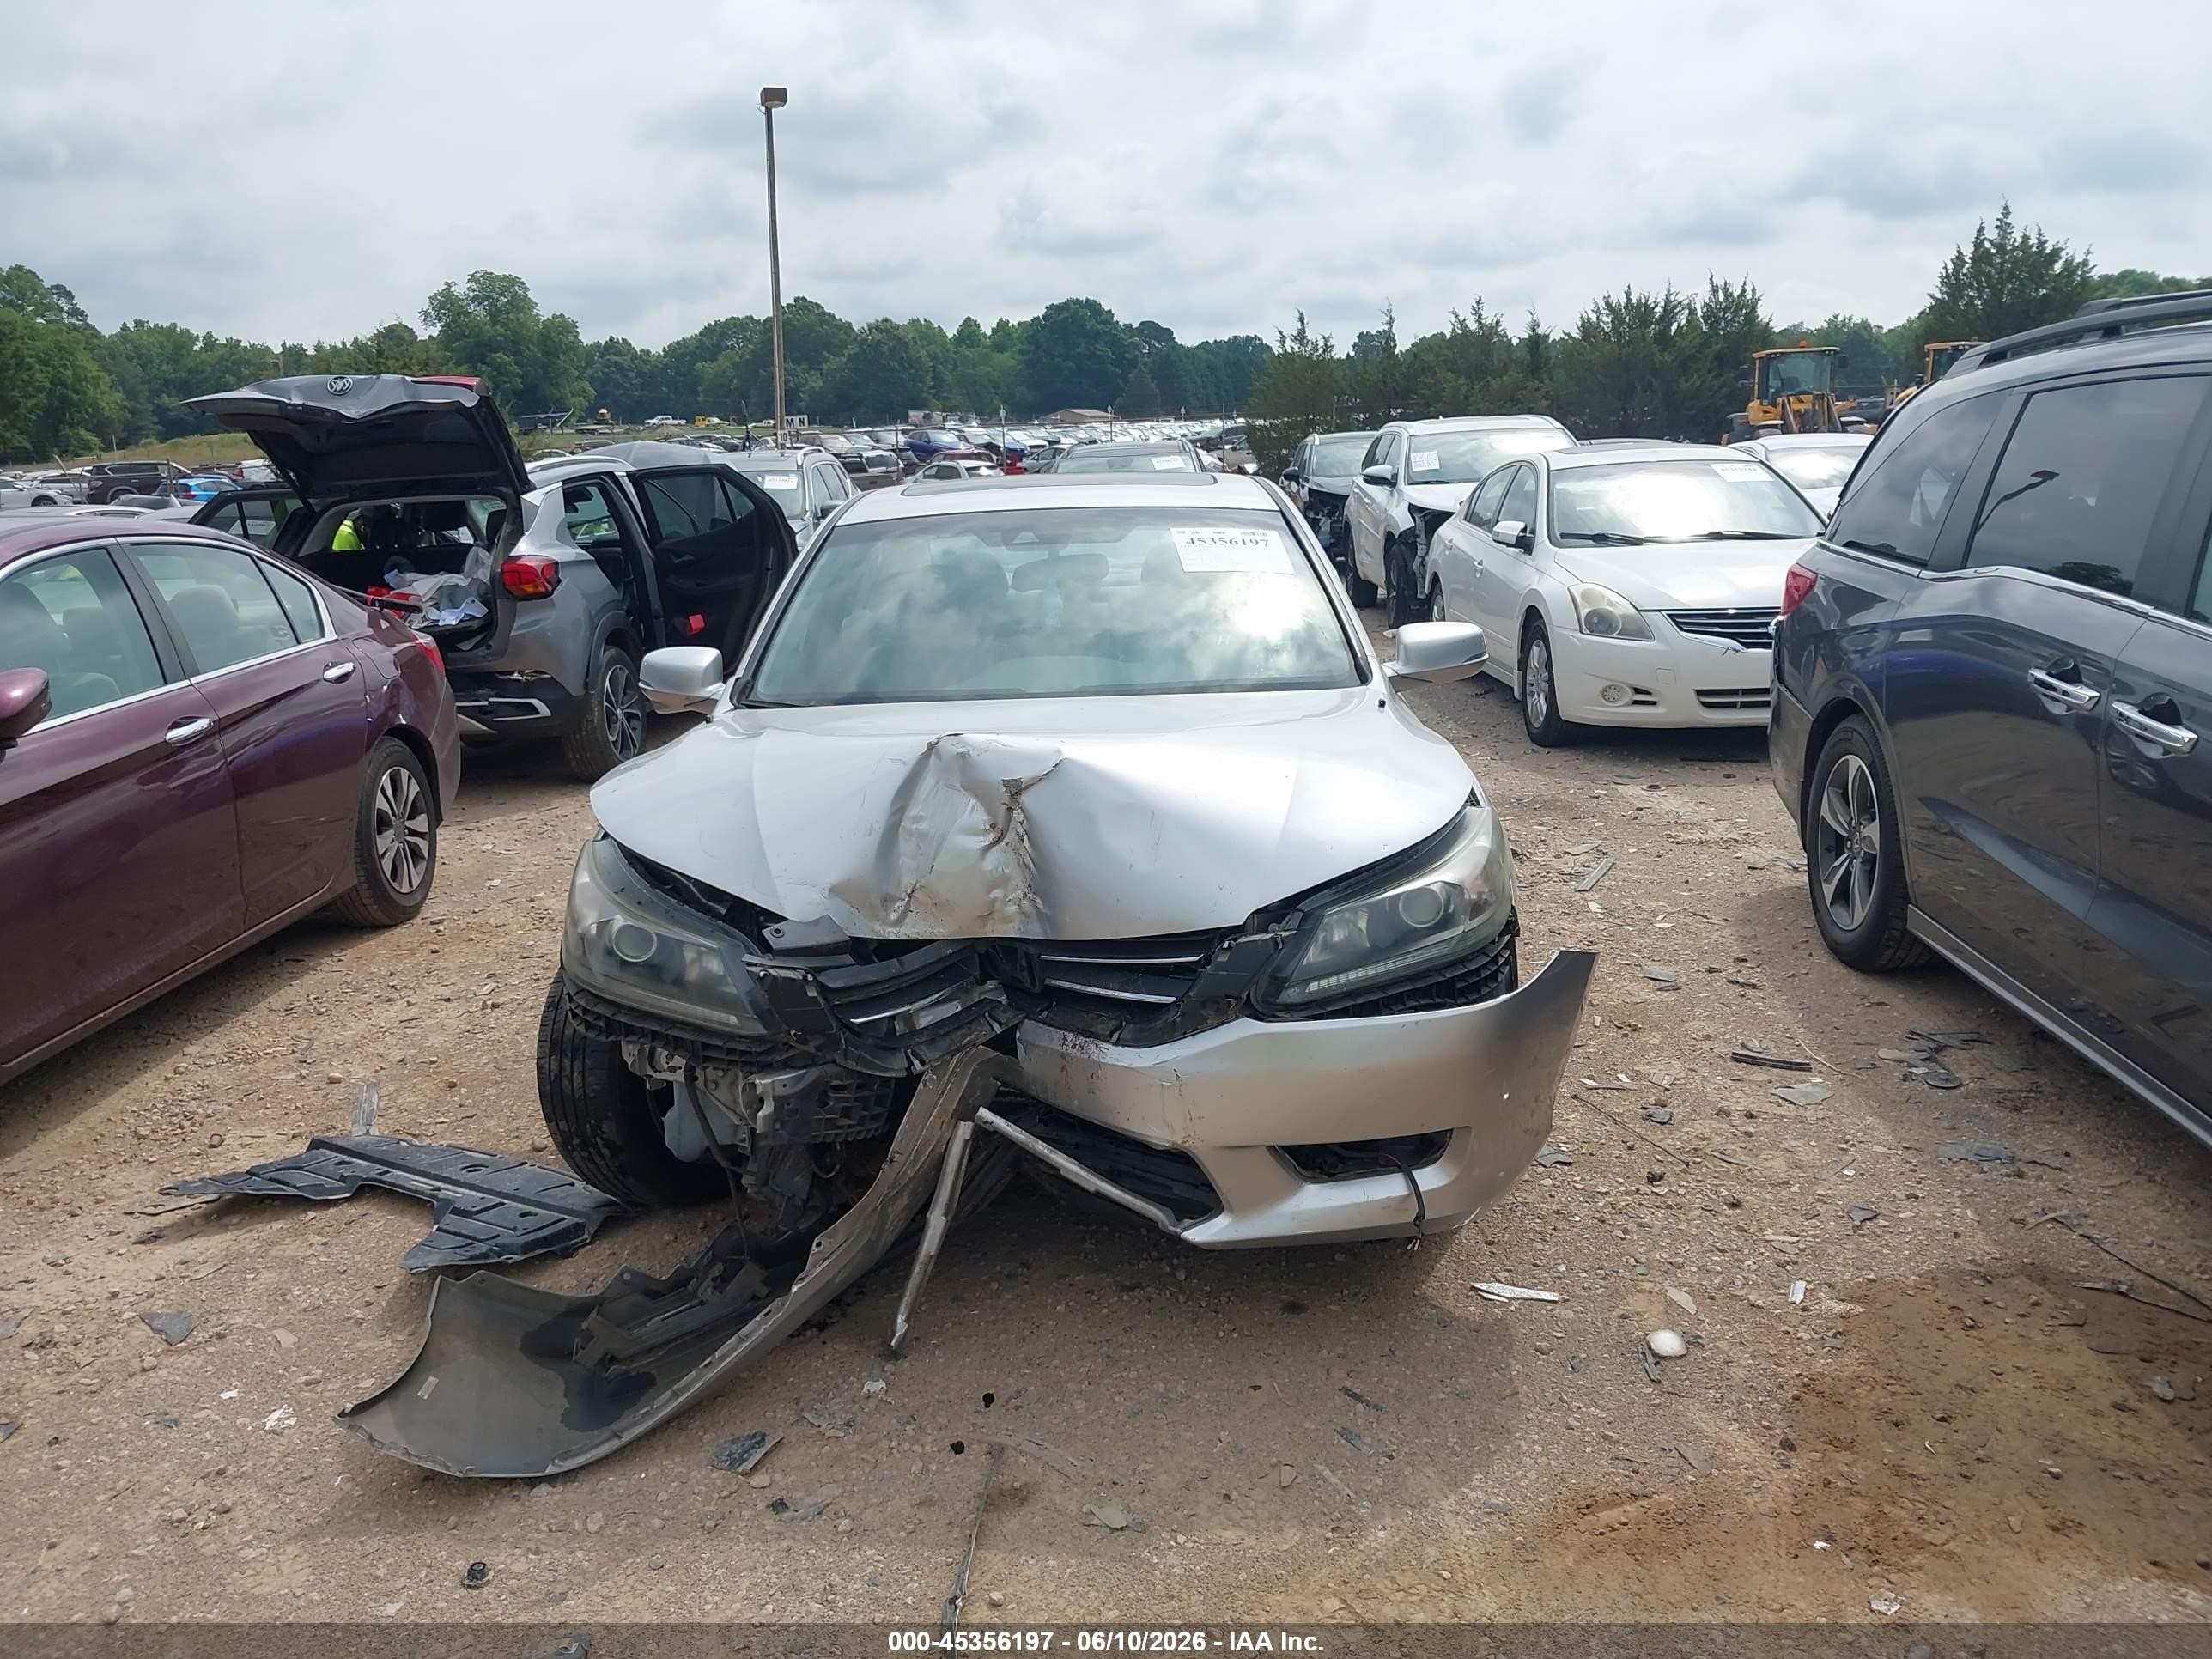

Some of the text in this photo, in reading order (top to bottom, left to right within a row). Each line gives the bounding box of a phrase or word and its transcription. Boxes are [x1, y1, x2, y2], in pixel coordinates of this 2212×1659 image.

[786, 416, 805, 428] M N
[779, 432, 788, 441] 10
[1186, 537, 1269, 547] 45356197
